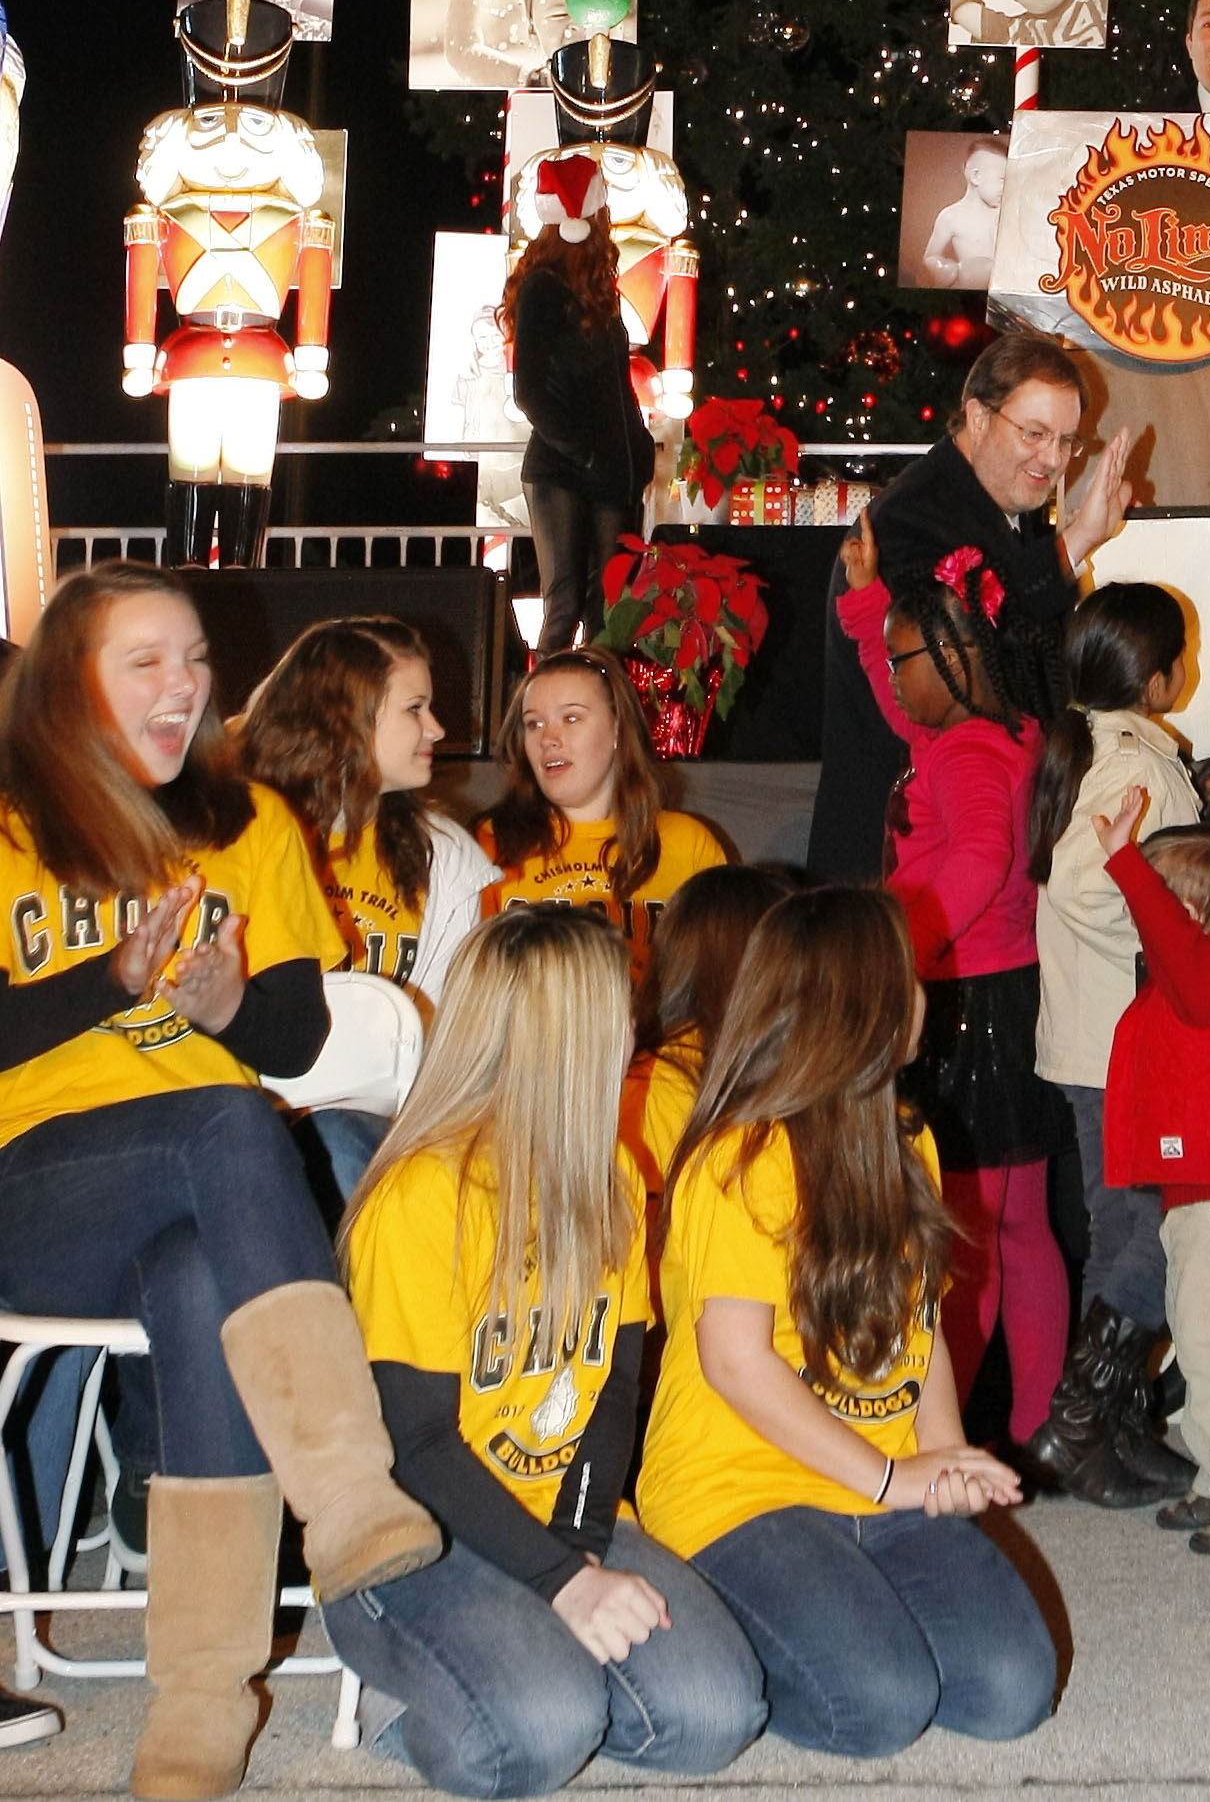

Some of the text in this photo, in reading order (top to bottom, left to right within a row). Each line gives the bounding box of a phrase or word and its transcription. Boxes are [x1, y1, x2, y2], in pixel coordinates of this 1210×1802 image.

[1097, 176, 1134, 205] TEXAS
[1137, 168, 1186, 181] MOTOR
[1101, 274, 1147, 292] WILD
[534, 861, 603, 885] CHISHOLM
[360, 890, 400, 921] TRAIL
[11, 883, 232, 977] CHOR
[496, 1439, 577, 1476] BULLDO
